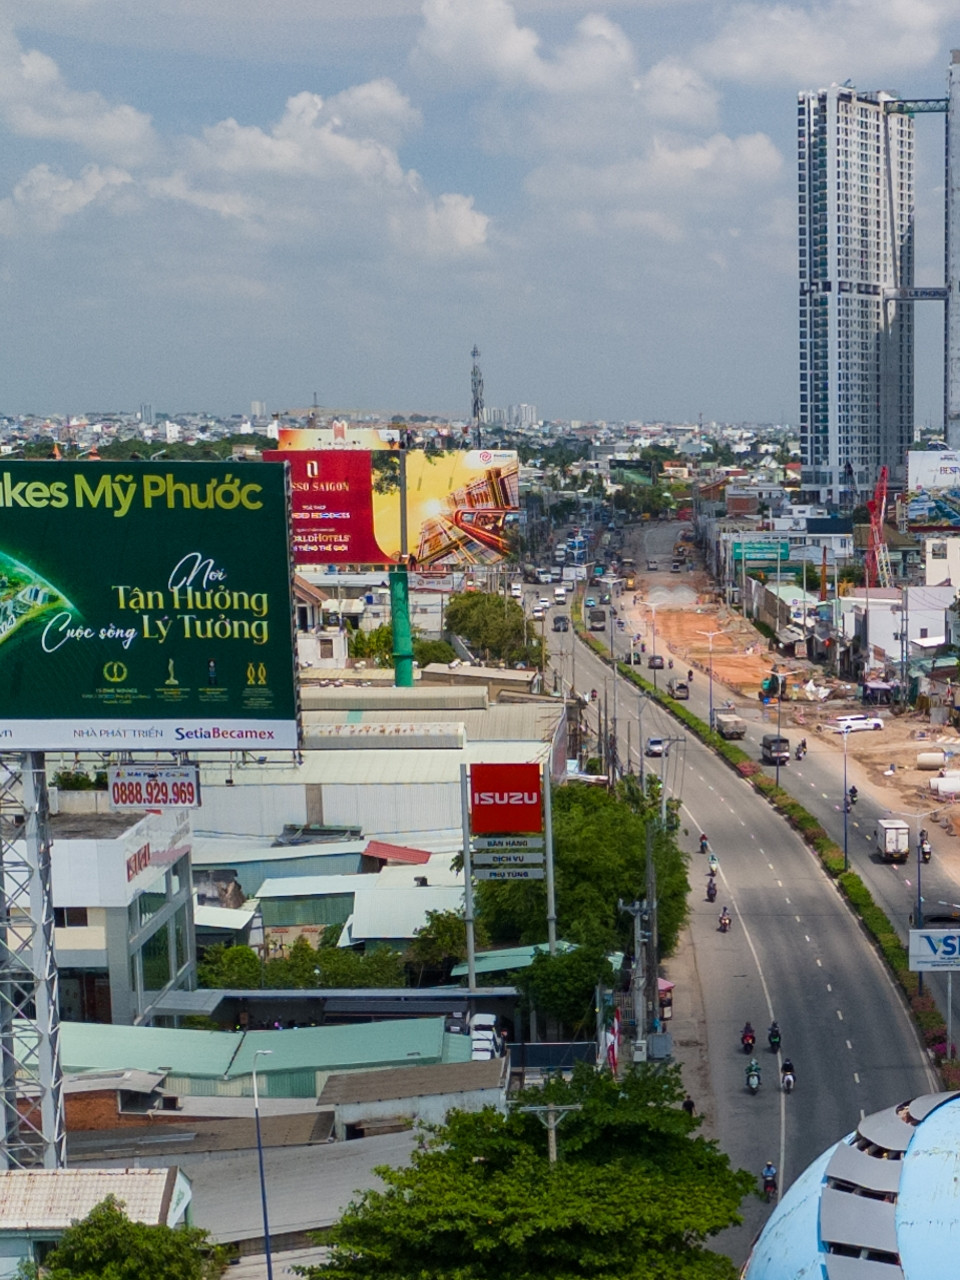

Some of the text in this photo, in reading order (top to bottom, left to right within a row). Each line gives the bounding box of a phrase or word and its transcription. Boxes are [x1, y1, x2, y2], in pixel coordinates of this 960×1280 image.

[0, 472, 264, 518] kes Mỹ Phước
[111, 584, 268, 617] Tận Hưởng
[41, 612, 95, 653] Cuộc
[142, 615, 171, 644] Lý
[177, 614, 268, 645] Tưởng
[175, 727, 275, 740] SetiaBecamex
[112, 782, 195, 805] 0888.929.969
[474, 792, 538, 805] ISUZU
